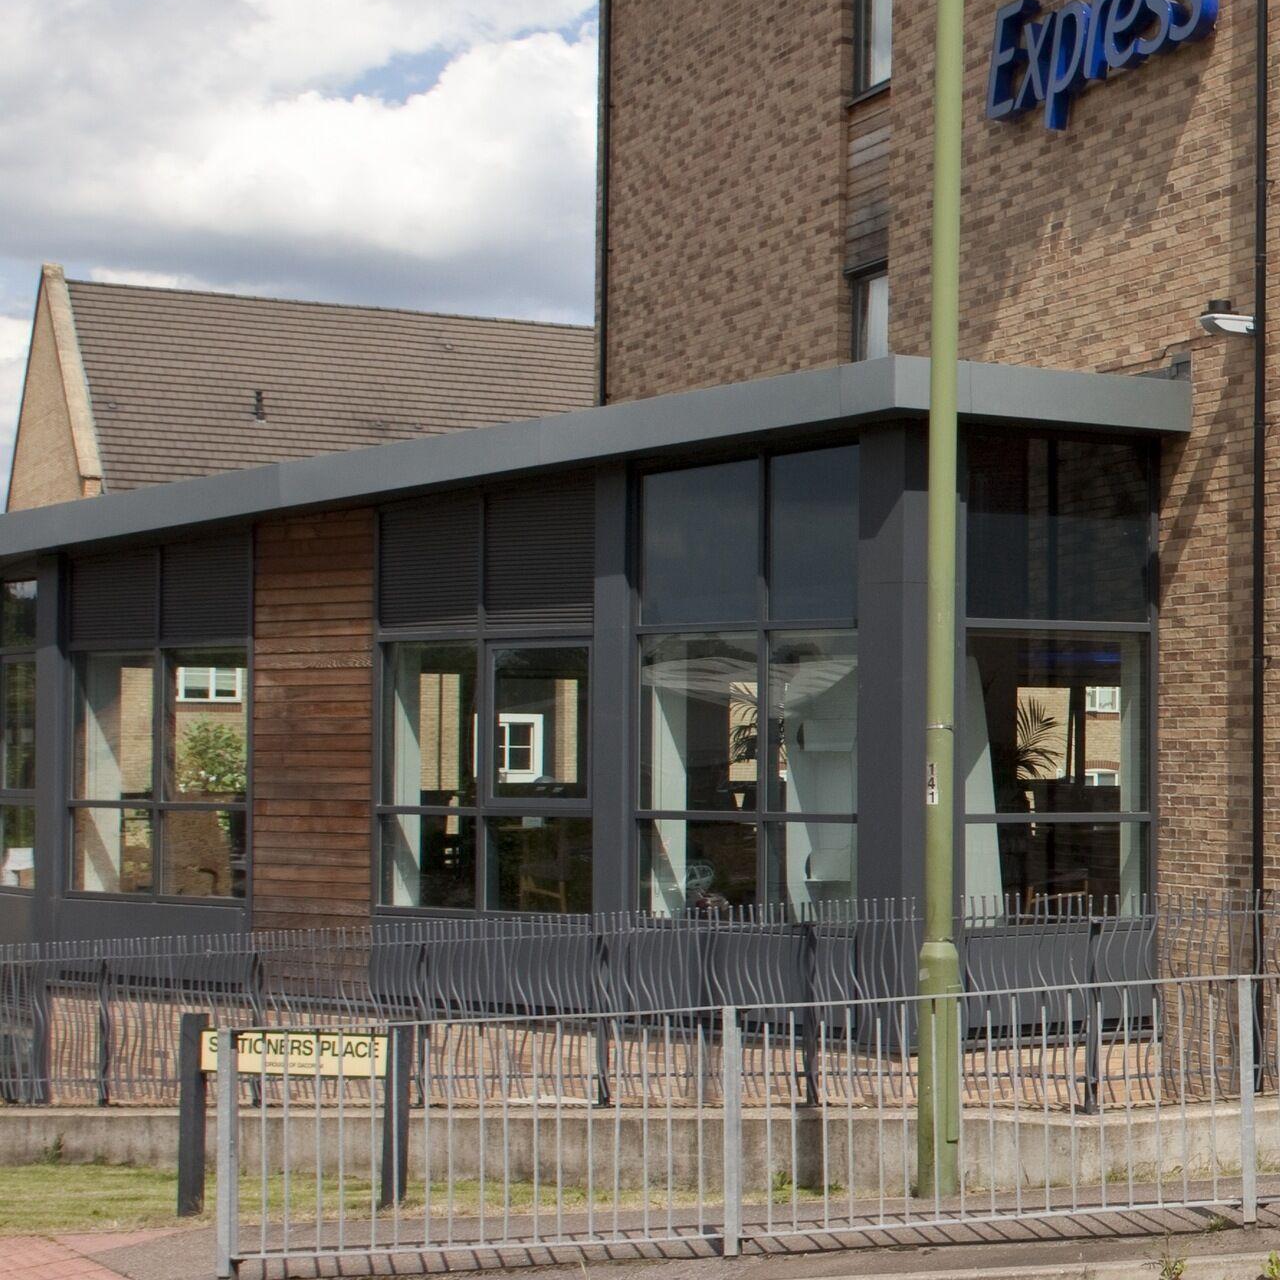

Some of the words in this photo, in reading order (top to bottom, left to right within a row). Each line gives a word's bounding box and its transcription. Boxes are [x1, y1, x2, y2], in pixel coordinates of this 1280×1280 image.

[927, 763, 936, 803] 141
[209, 1036, 313, 1056] STIONERS
[320, 1040, 379, 1059] PLACE
